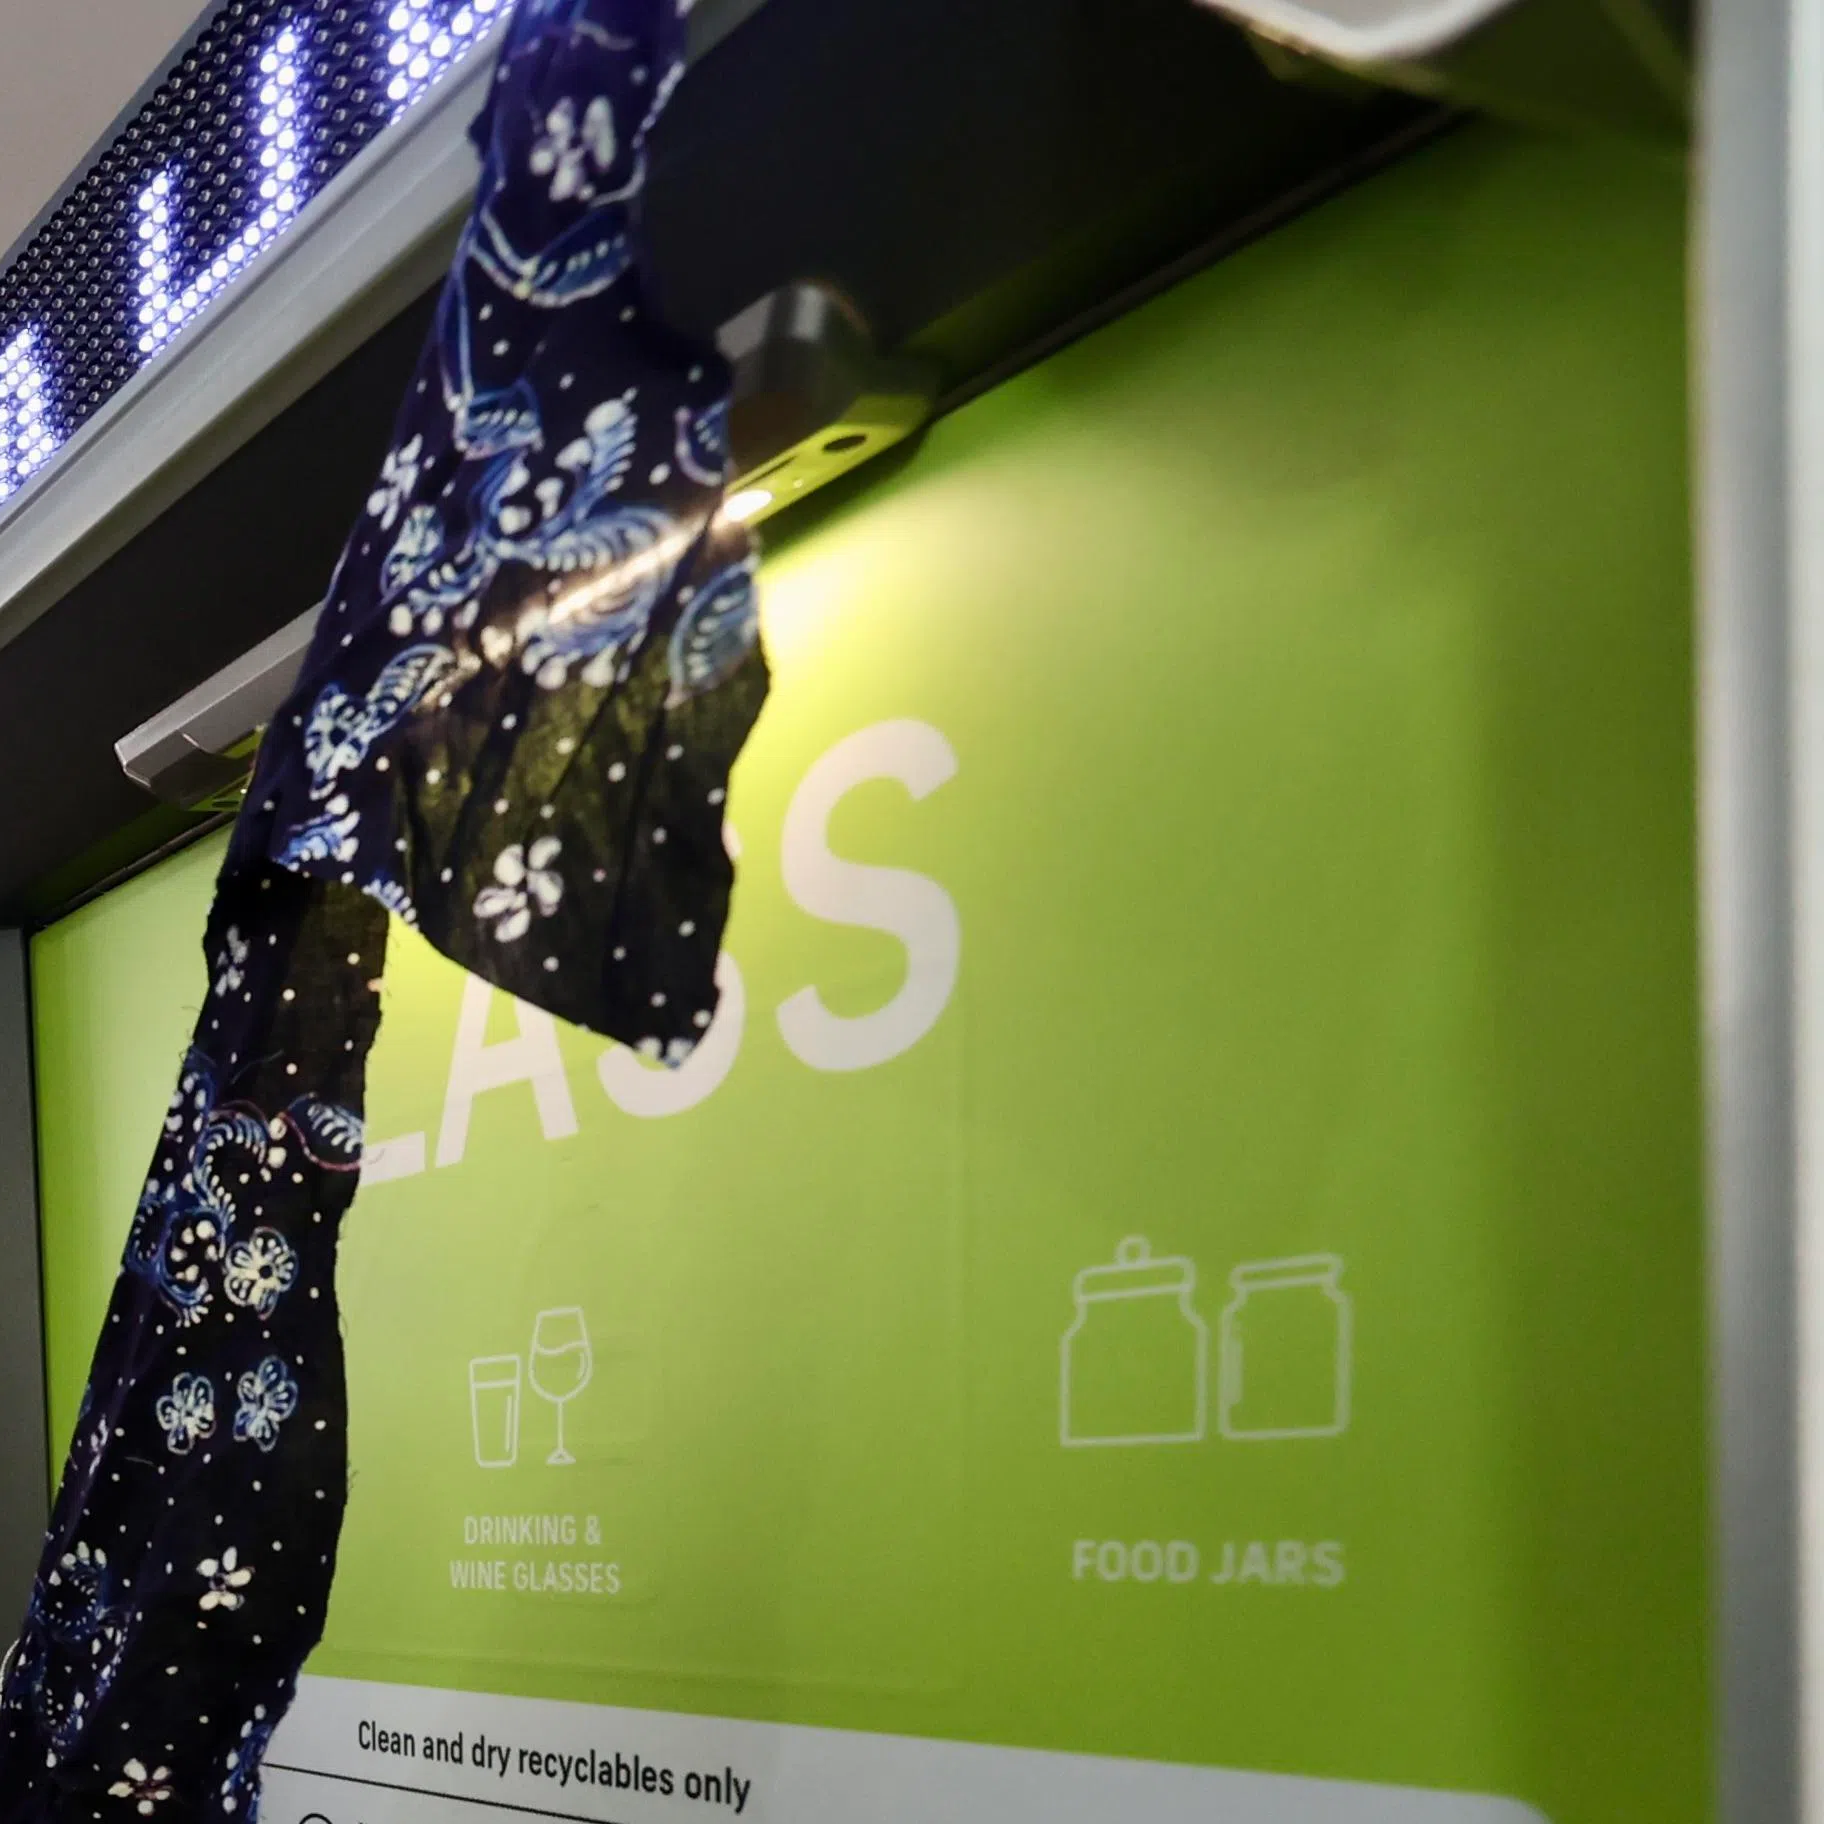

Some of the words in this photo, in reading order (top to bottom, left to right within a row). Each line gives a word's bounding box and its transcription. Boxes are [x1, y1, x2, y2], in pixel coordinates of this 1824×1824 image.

[463, 1513, 577, 1546] DRINKING
[585, 1513, 602, 1546] &
[449, 1559, 507, 1590] WINE
[513, 1560, 622, 1596] GLASSES
[1071, 1539, 1200, 1583] FOOD
[1211, 1540, 1346, 1587] JARS
[358, 1719, 416, 1757] Clean
[423, 1731, 463, 1765] and
[472, 1735, 511, 1777] dry
[518, 1749, 675, 1796] recyclables
[684, 1767, 751, 1814] only
